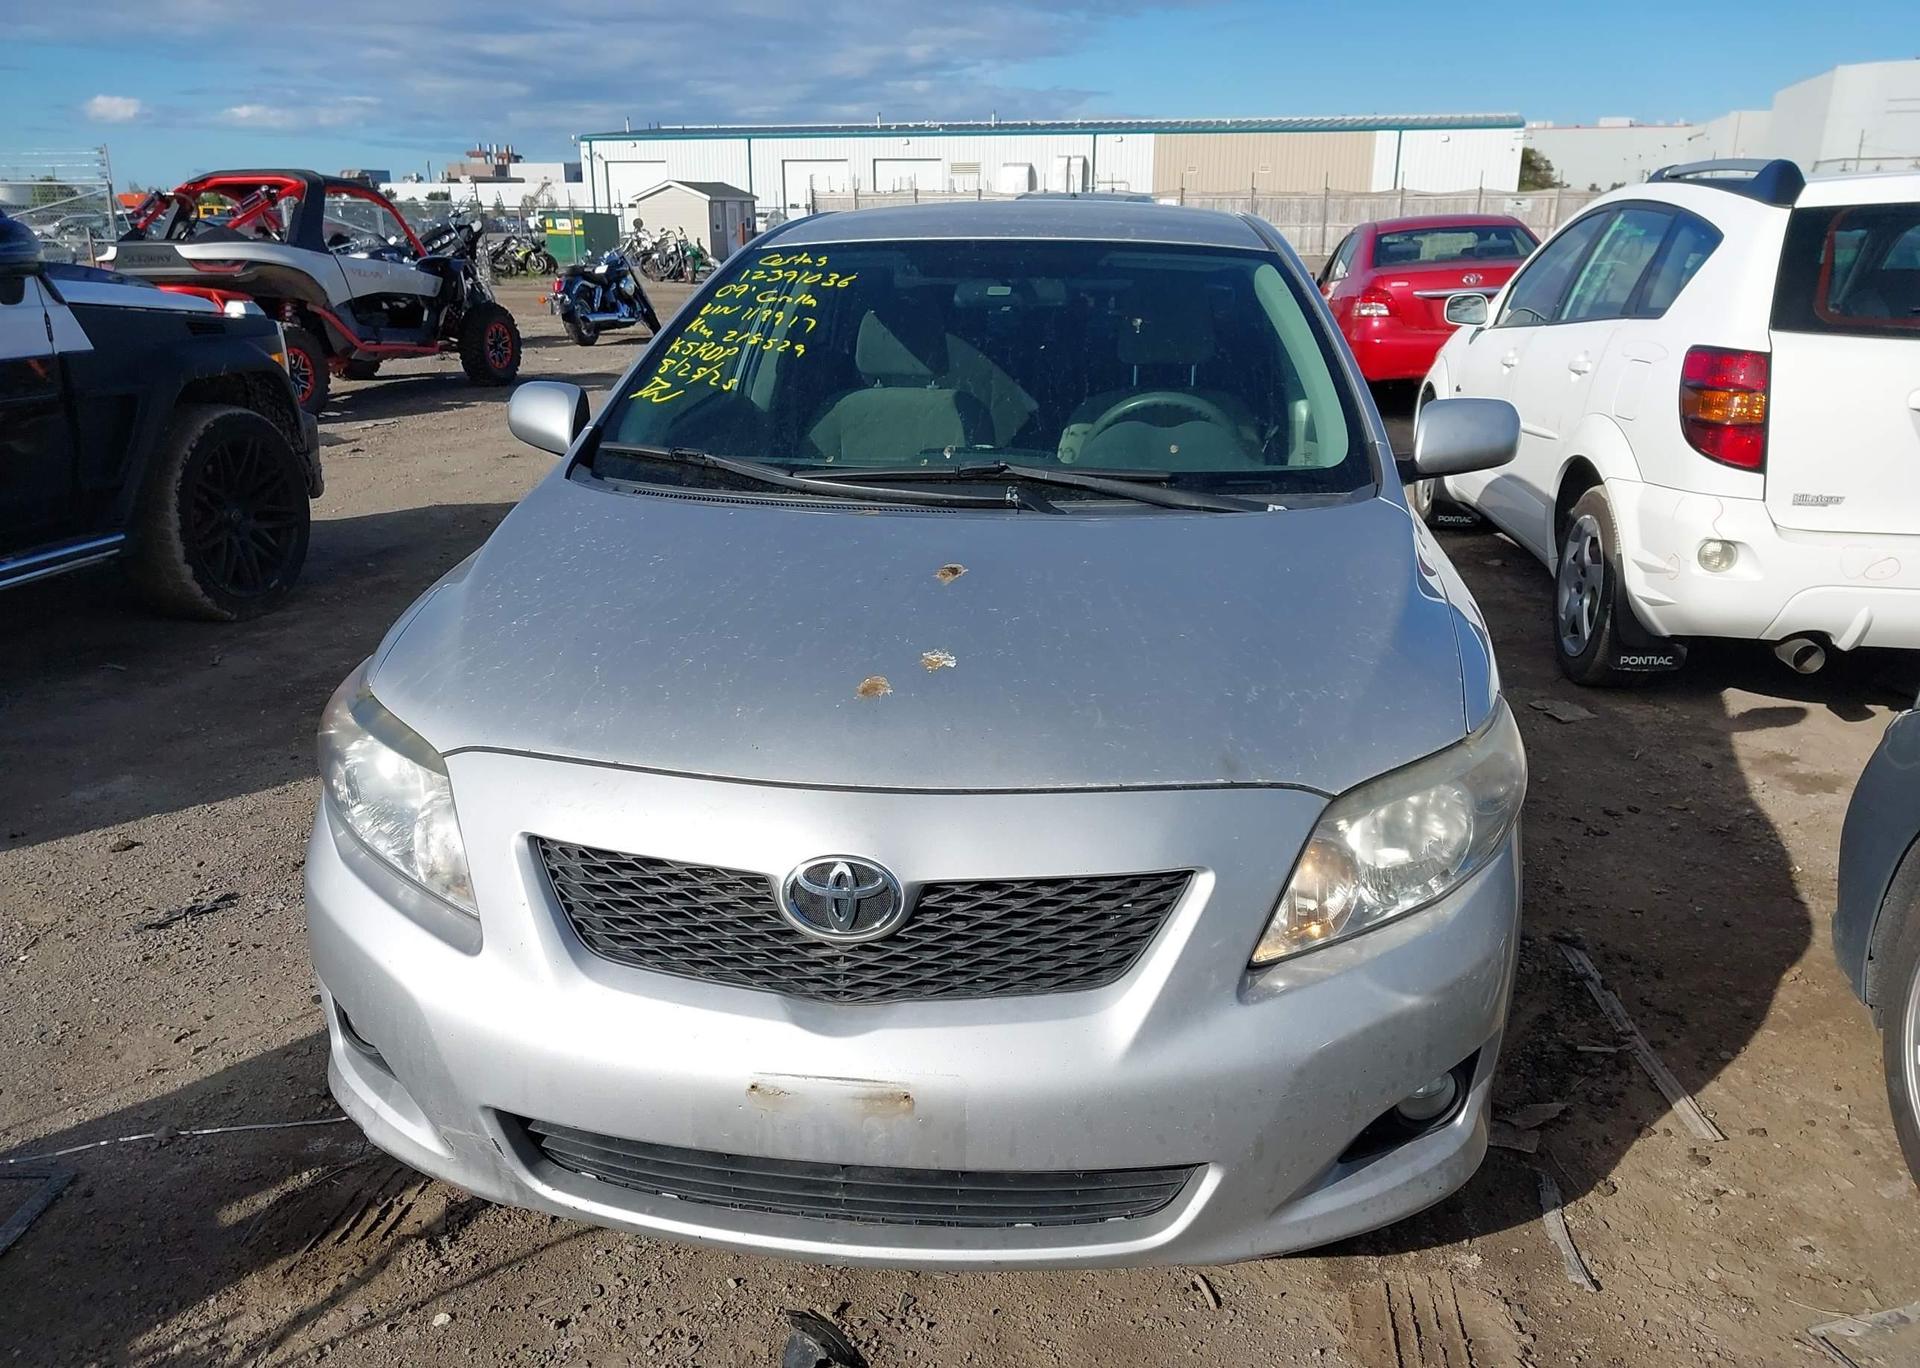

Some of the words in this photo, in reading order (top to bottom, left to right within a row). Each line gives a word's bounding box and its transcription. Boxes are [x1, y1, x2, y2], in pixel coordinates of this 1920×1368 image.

[739, 269, 859, 288] 12391036
[700, 303, 741, 315] VIN
[1438, 515, 1472, 523] PONTIAC
[1620, 655, 1673, 665] PONTIAC
